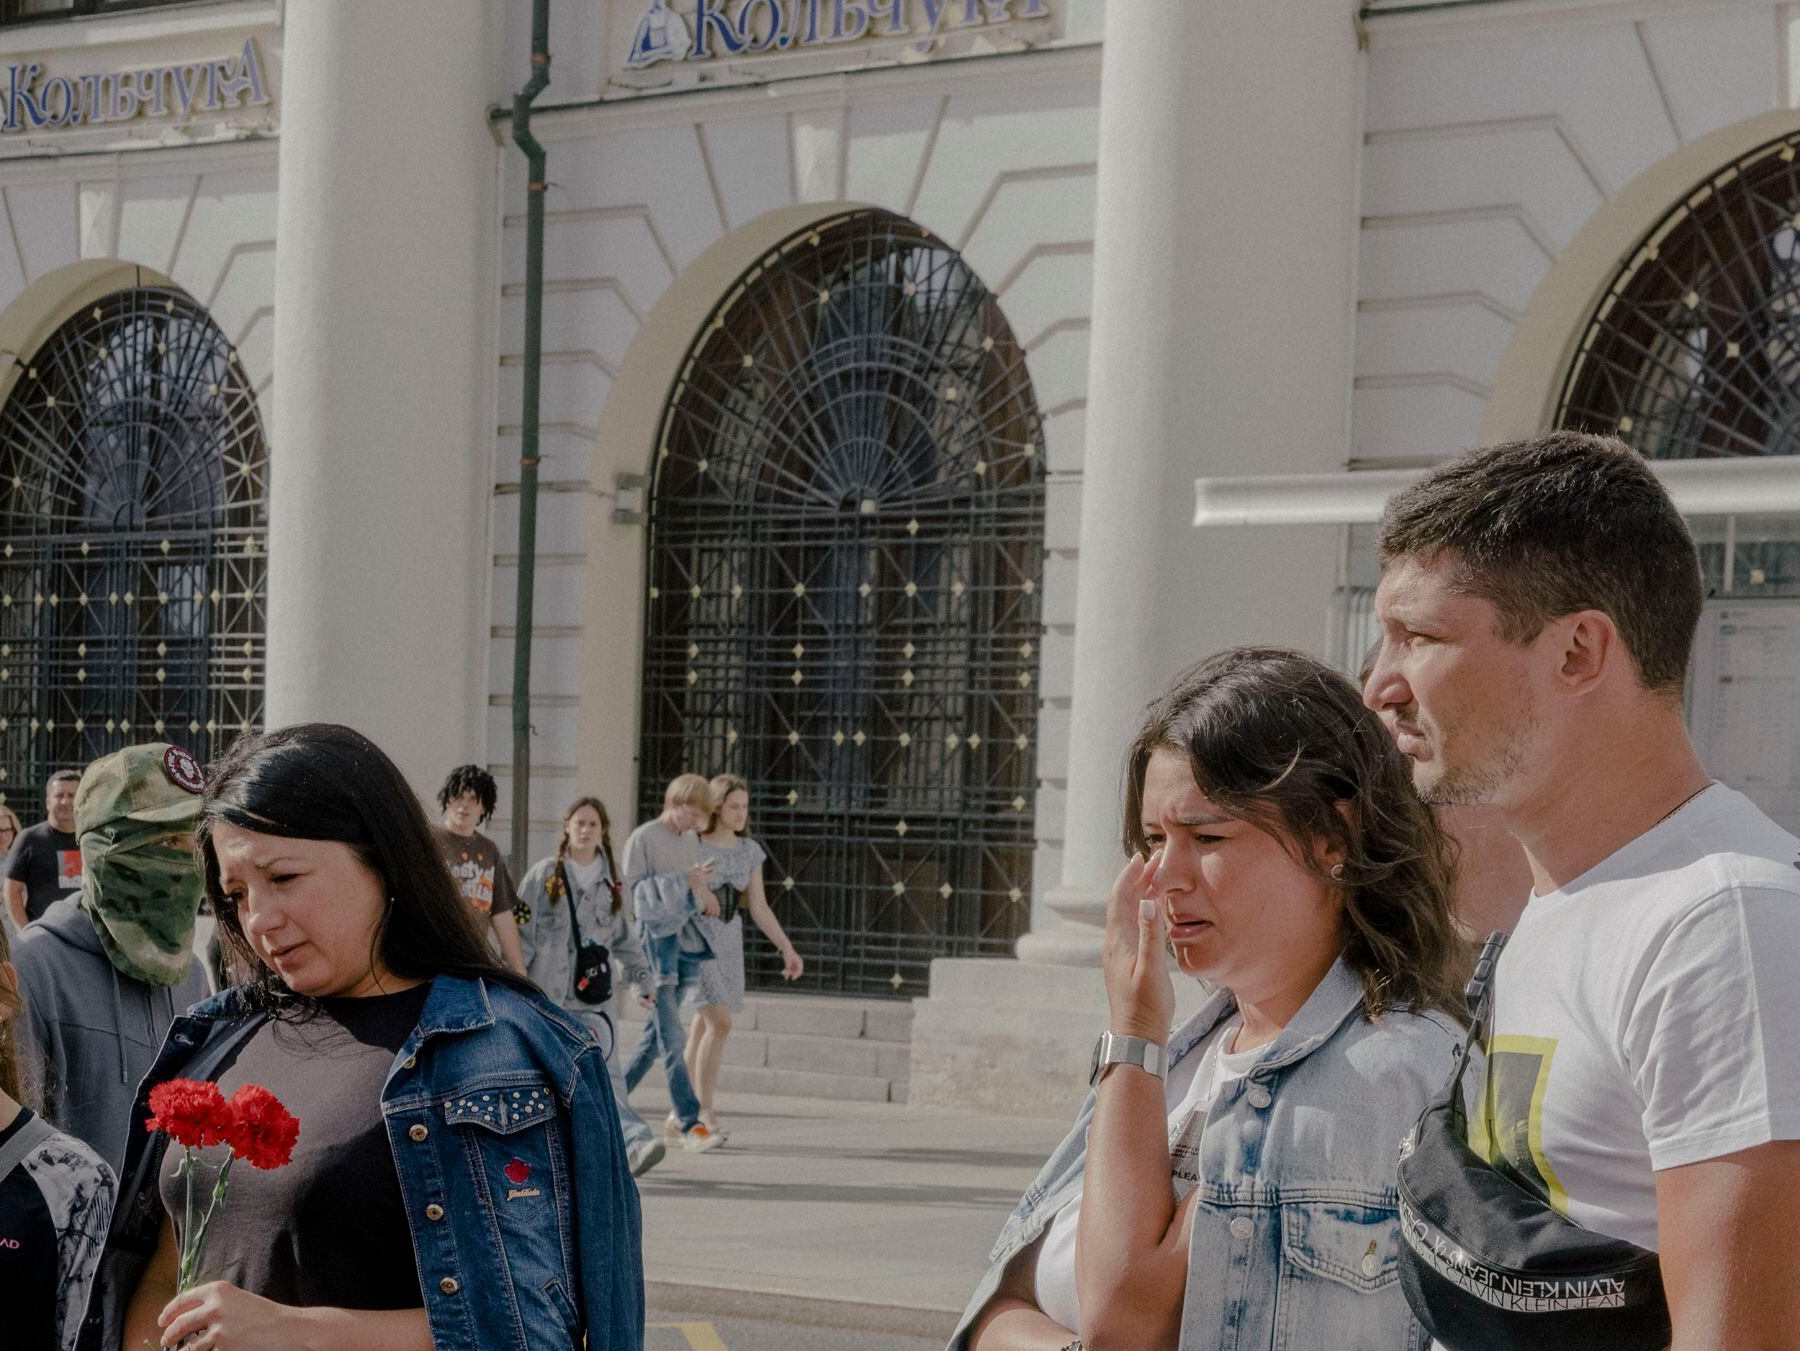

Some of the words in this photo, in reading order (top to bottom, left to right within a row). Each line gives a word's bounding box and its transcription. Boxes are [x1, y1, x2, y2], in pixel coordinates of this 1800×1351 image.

[689, 0, 1049, 58] КОЛЬЧУ
[1502, 1275, 1559, 1299] KLEIN
[1511, 1295, 1569, 1313] KLEIN
